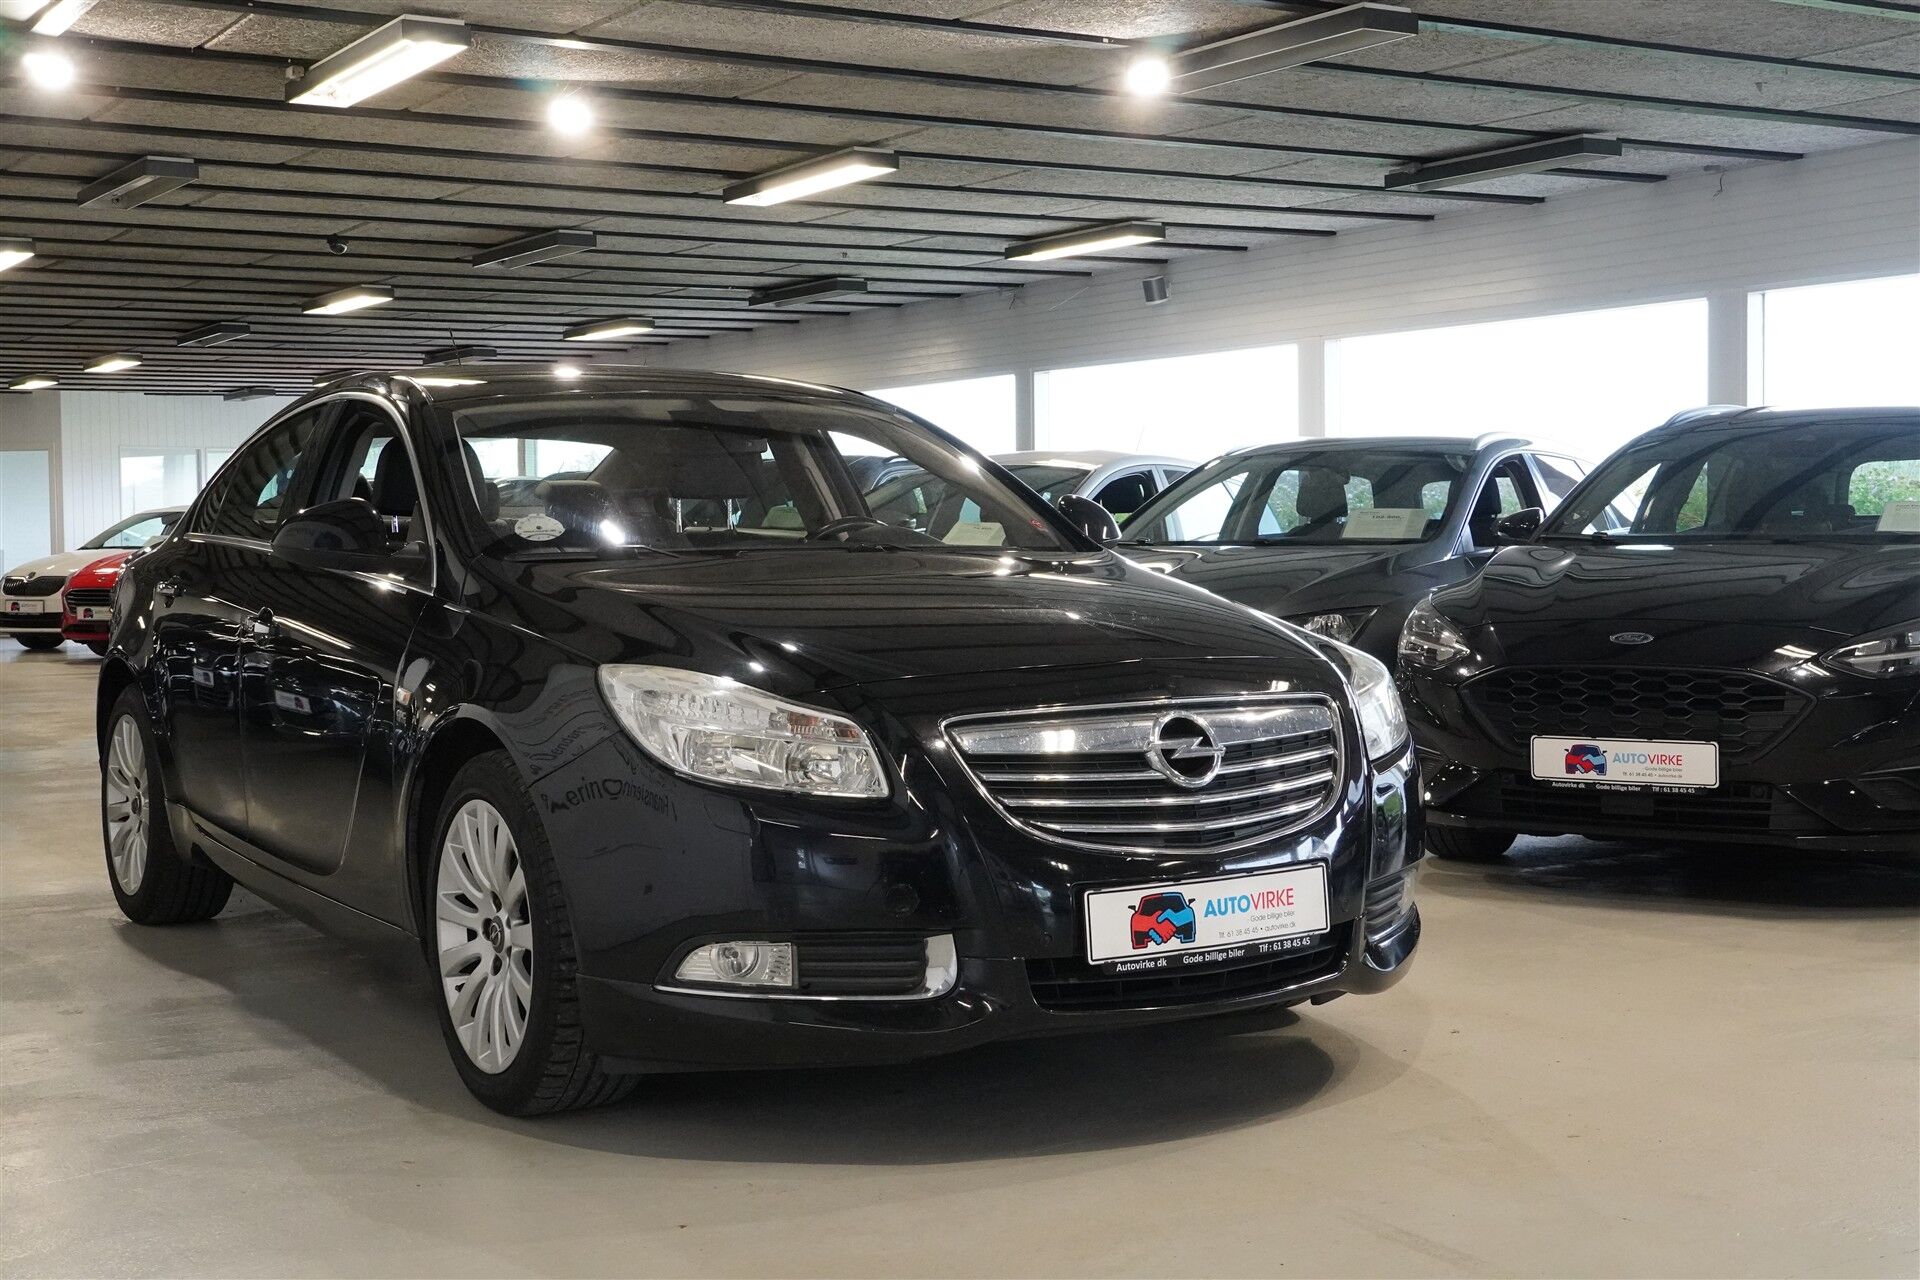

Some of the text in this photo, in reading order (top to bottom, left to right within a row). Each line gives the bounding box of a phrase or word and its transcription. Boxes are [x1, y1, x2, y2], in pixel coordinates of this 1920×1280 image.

[1612, 752, 1683, 766] AUTOVIRKE
[1204, 888, 1294, 918] AUTOVIRKE
[1250, 910, 1295, 922] Gode billige biler
[1244, 927, 1251, 935] 45
[1116, 959, 1155, 972] Autovirke
[1157, 957, 1167, 967] dk
[1183, 953, 1203, 964] Gode
[1228, 948, 1245, 958] biler
[1273, 942, 1281, 951] 61
[1283, 940, 1292, 949] 38
[1293, 938, 1301, 947] 45
[1302, 937, 1311, 945] 45
